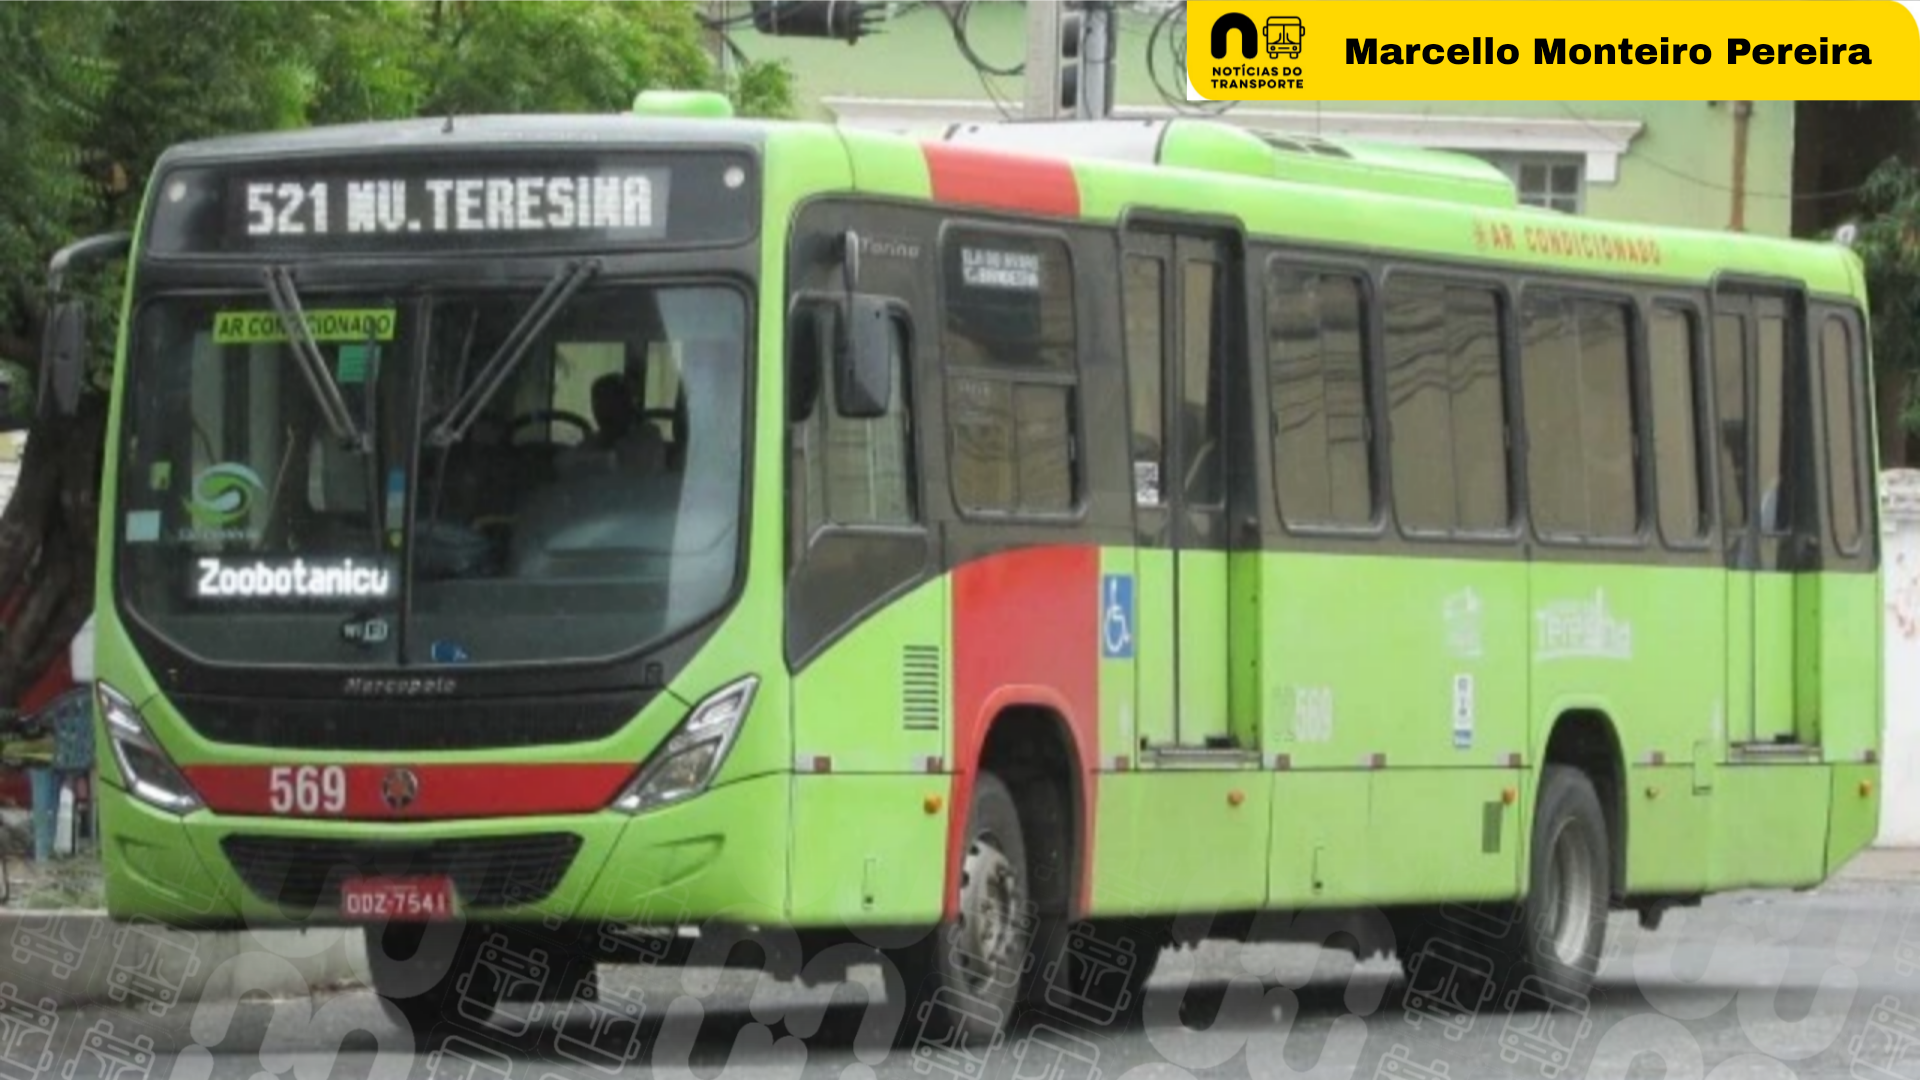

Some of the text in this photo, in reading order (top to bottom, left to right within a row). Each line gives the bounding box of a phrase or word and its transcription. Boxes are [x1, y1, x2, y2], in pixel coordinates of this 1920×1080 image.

[246, 182, 329, 235] 521
[1490, 220, 1661, 266] AR CONDICIONADO
[218, 317, 244, 337] AR
[269, 764, 346, 813] 569
